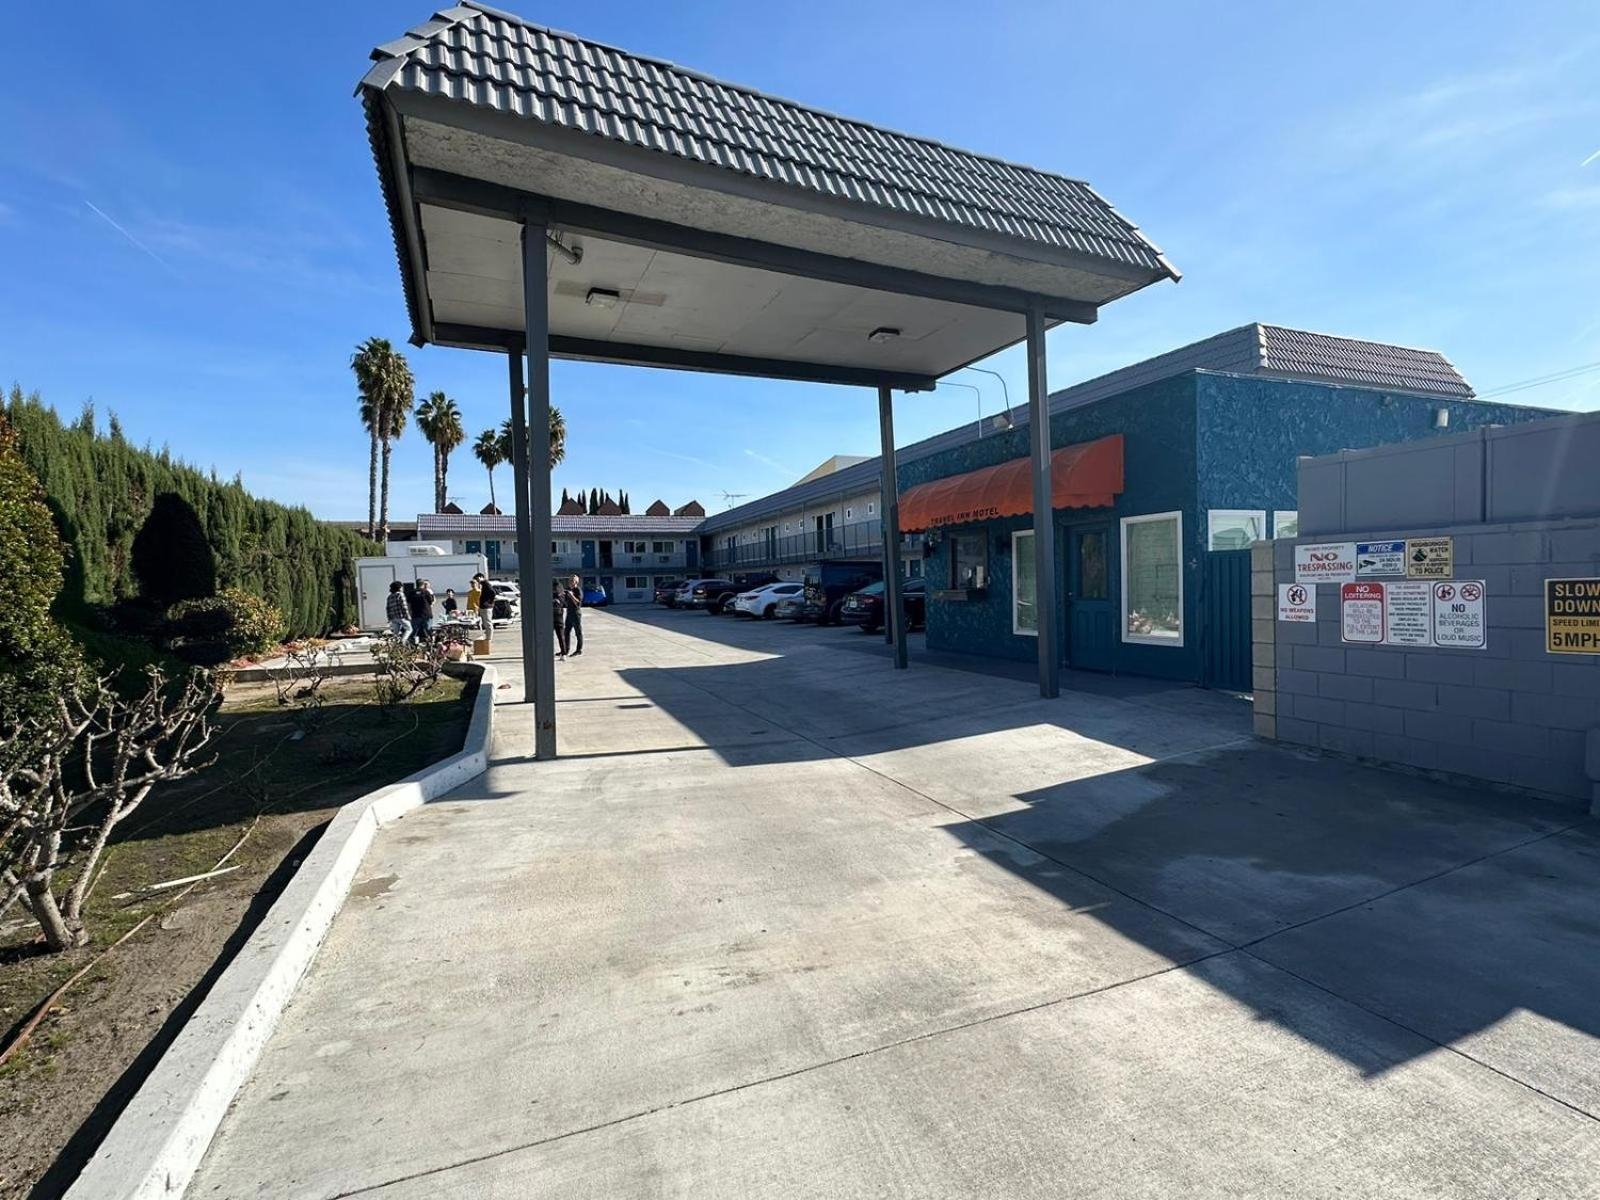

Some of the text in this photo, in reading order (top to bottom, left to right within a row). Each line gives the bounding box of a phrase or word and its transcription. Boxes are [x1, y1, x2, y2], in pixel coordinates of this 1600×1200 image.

[973, 507, 999, 517] MOTEL
[1367, 543, 1393, 553] NOTICE
[1310, 552, 1338, 561] NO
[1297, 561, 1353, 572] TRESPASSING
[1356, 585, 1369, 593] NO
[1555, 583, 1600, 597] SLOW
[1451, 603, 1465, 612] NO
[1554, 599, 1600, 613] DOWN
[1553, 618, 1600, 627] SPEED LIMI
[1458, 634, 1481, 642] MUSIC
